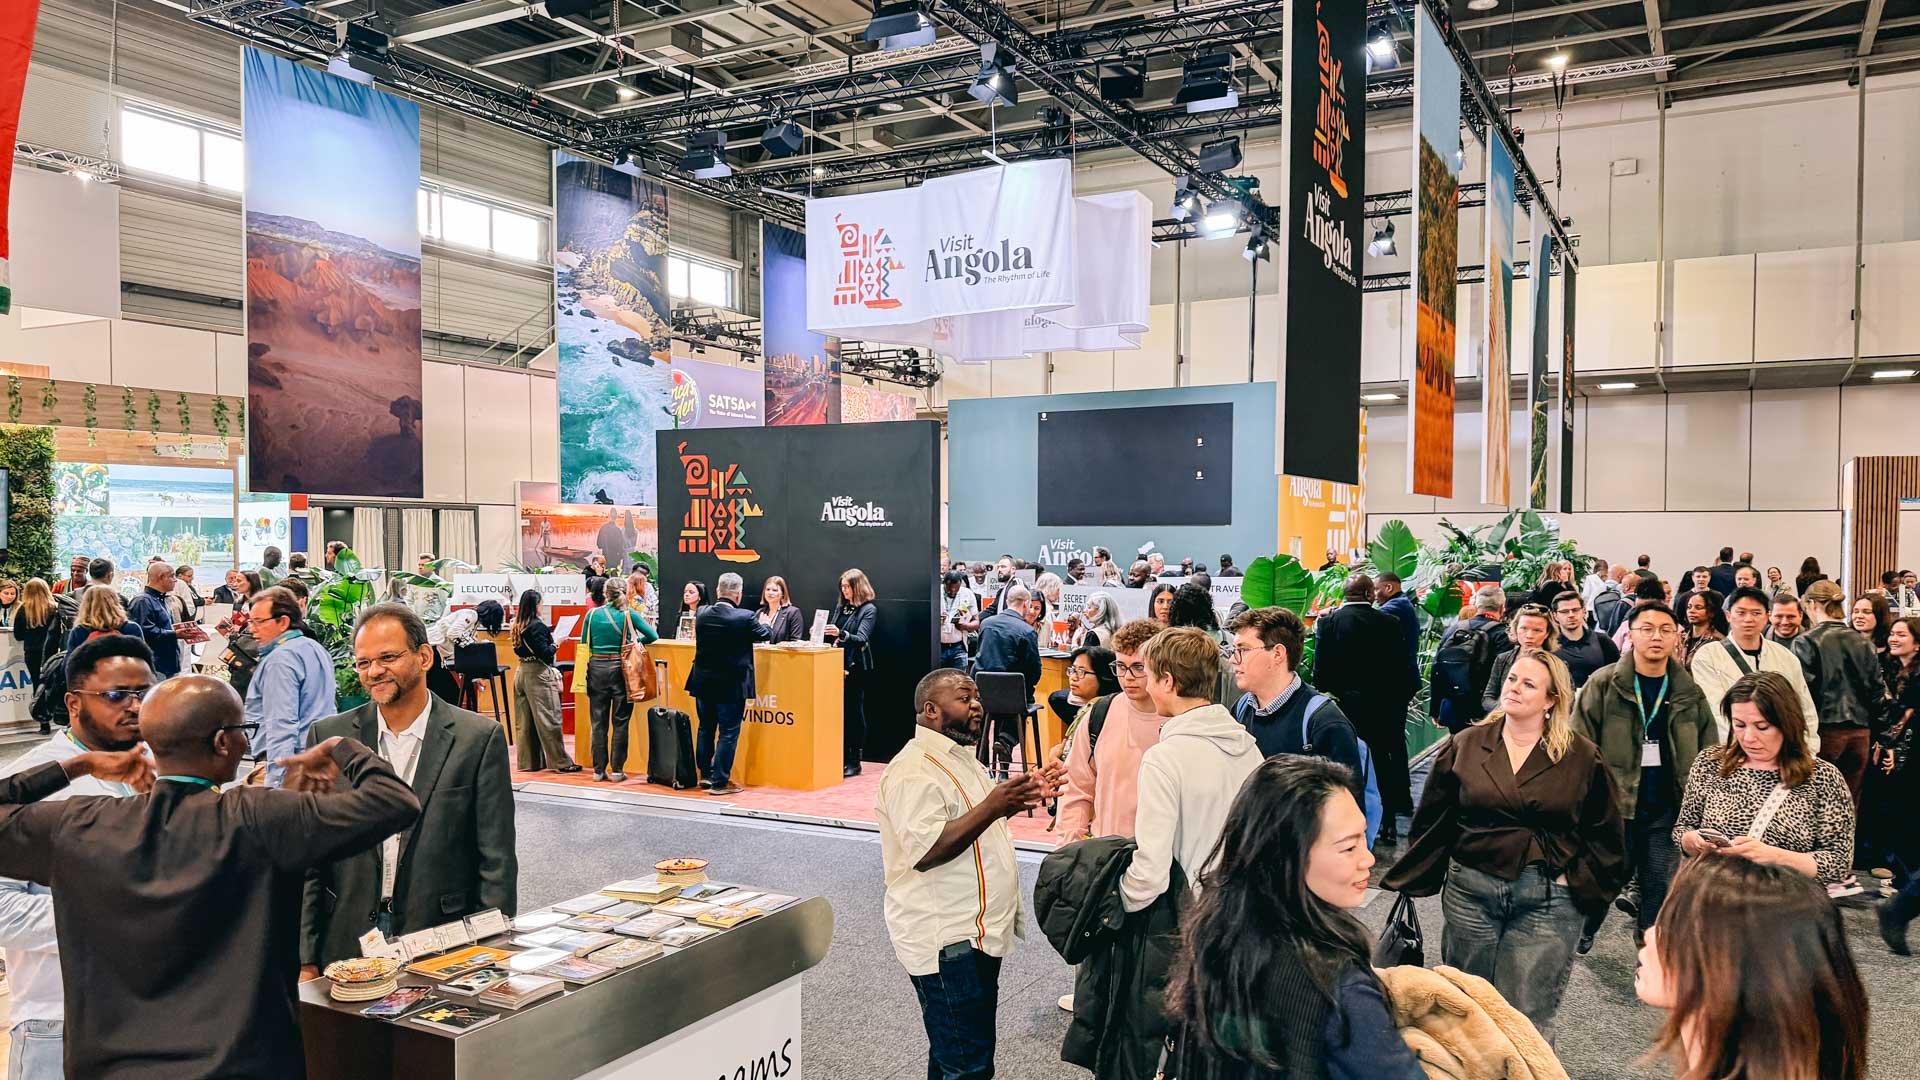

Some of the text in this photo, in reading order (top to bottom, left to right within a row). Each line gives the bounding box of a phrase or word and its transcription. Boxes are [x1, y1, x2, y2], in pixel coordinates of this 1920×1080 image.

[1314, 182, 1331, 217] Visit
[1304, 191, 1352, 271] Angola
[940, 234, 974, 253] Visit
[925, 238, 1033, 286] Angola
[984, 270, 1051, 284] The Rhythm of Life
[671, 380, 696, 401] rica's
[709, 394, 746, 412] SATSA
[1289, 476, 1322, 507] Angola
[832, 495, 853, 507] Visit
[821, 501, 885, 527] Angola
[1050, 538, 1075, 550] Visit
[1037, 544, 1098, 569] Angol
[1211, 585, 1240, 593] TRAVE
[1063, 593, 1087, 604] SECRET
[0, 693, 27, 703] OAST
[743, 709, 794, 726] VINDOS
